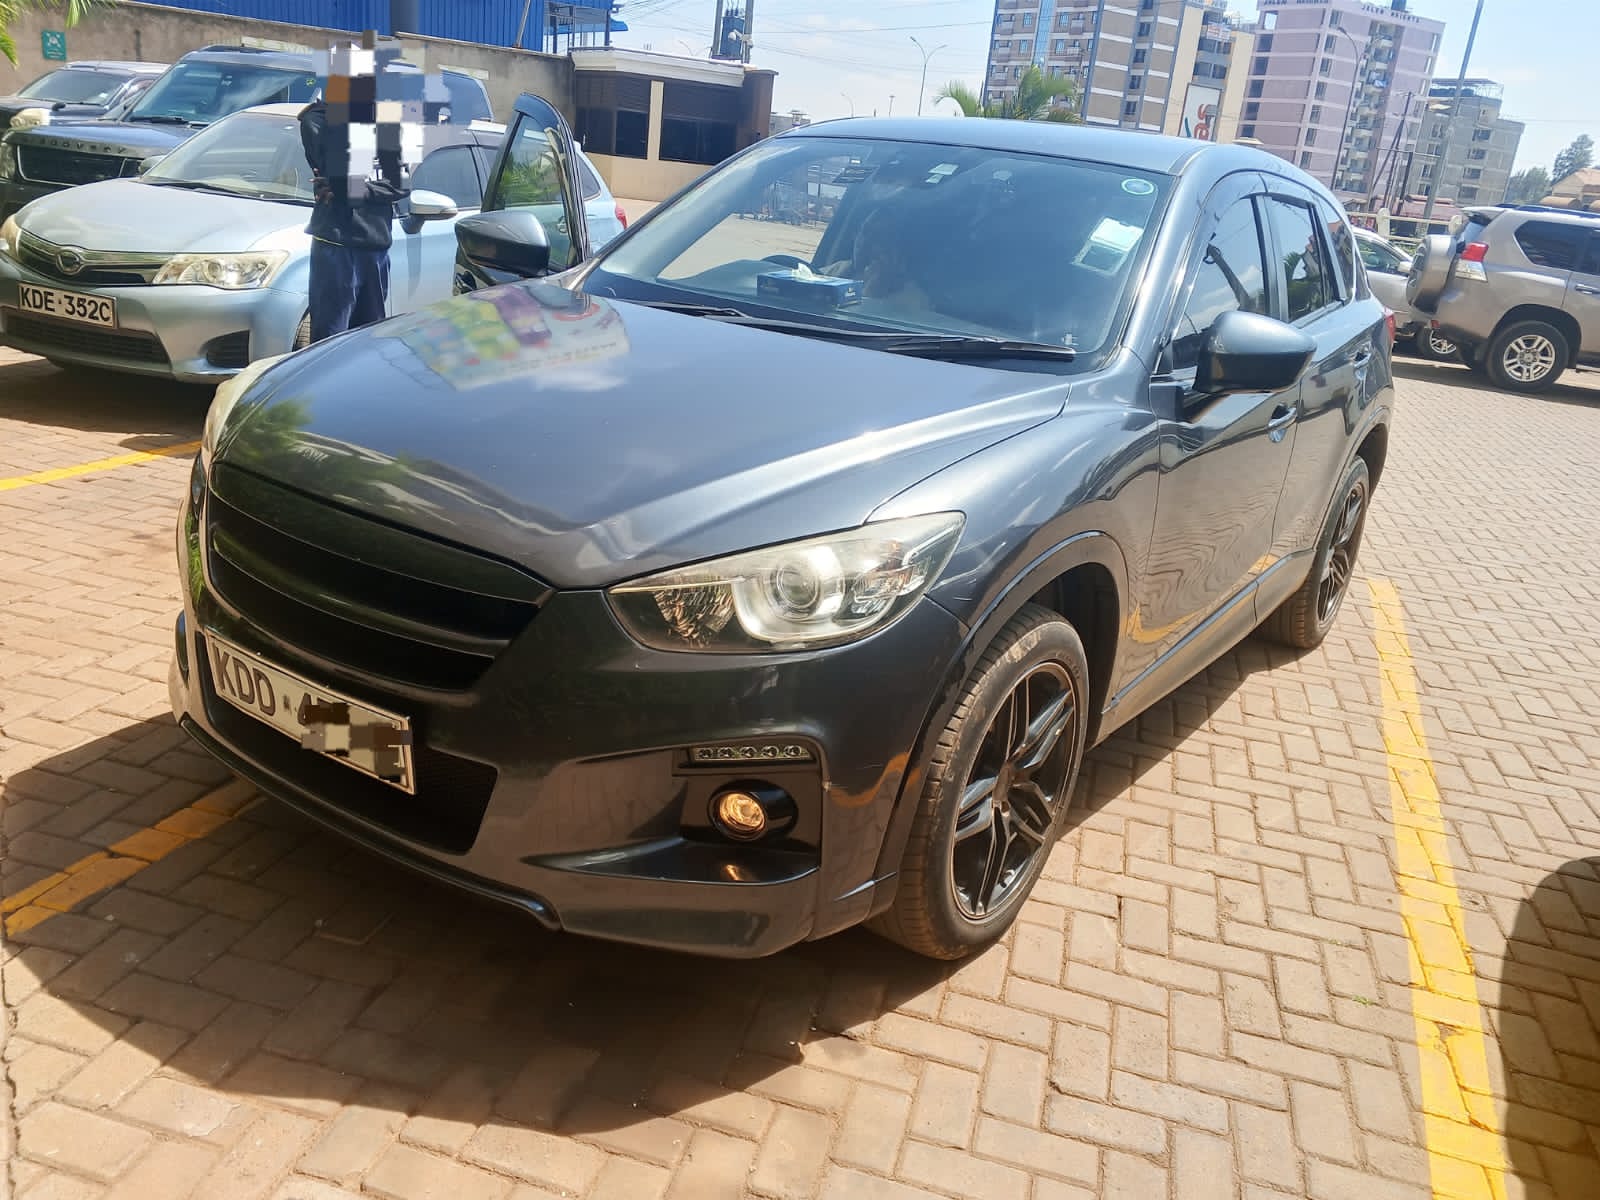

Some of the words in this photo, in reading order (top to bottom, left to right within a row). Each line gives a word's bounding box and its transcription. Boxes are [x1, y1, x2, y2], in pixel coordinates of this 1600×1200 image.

[20, 287, 55, 312] KDE
[64, 295, 110, 321] 352C
[213, 643, 276, 716] KDD
